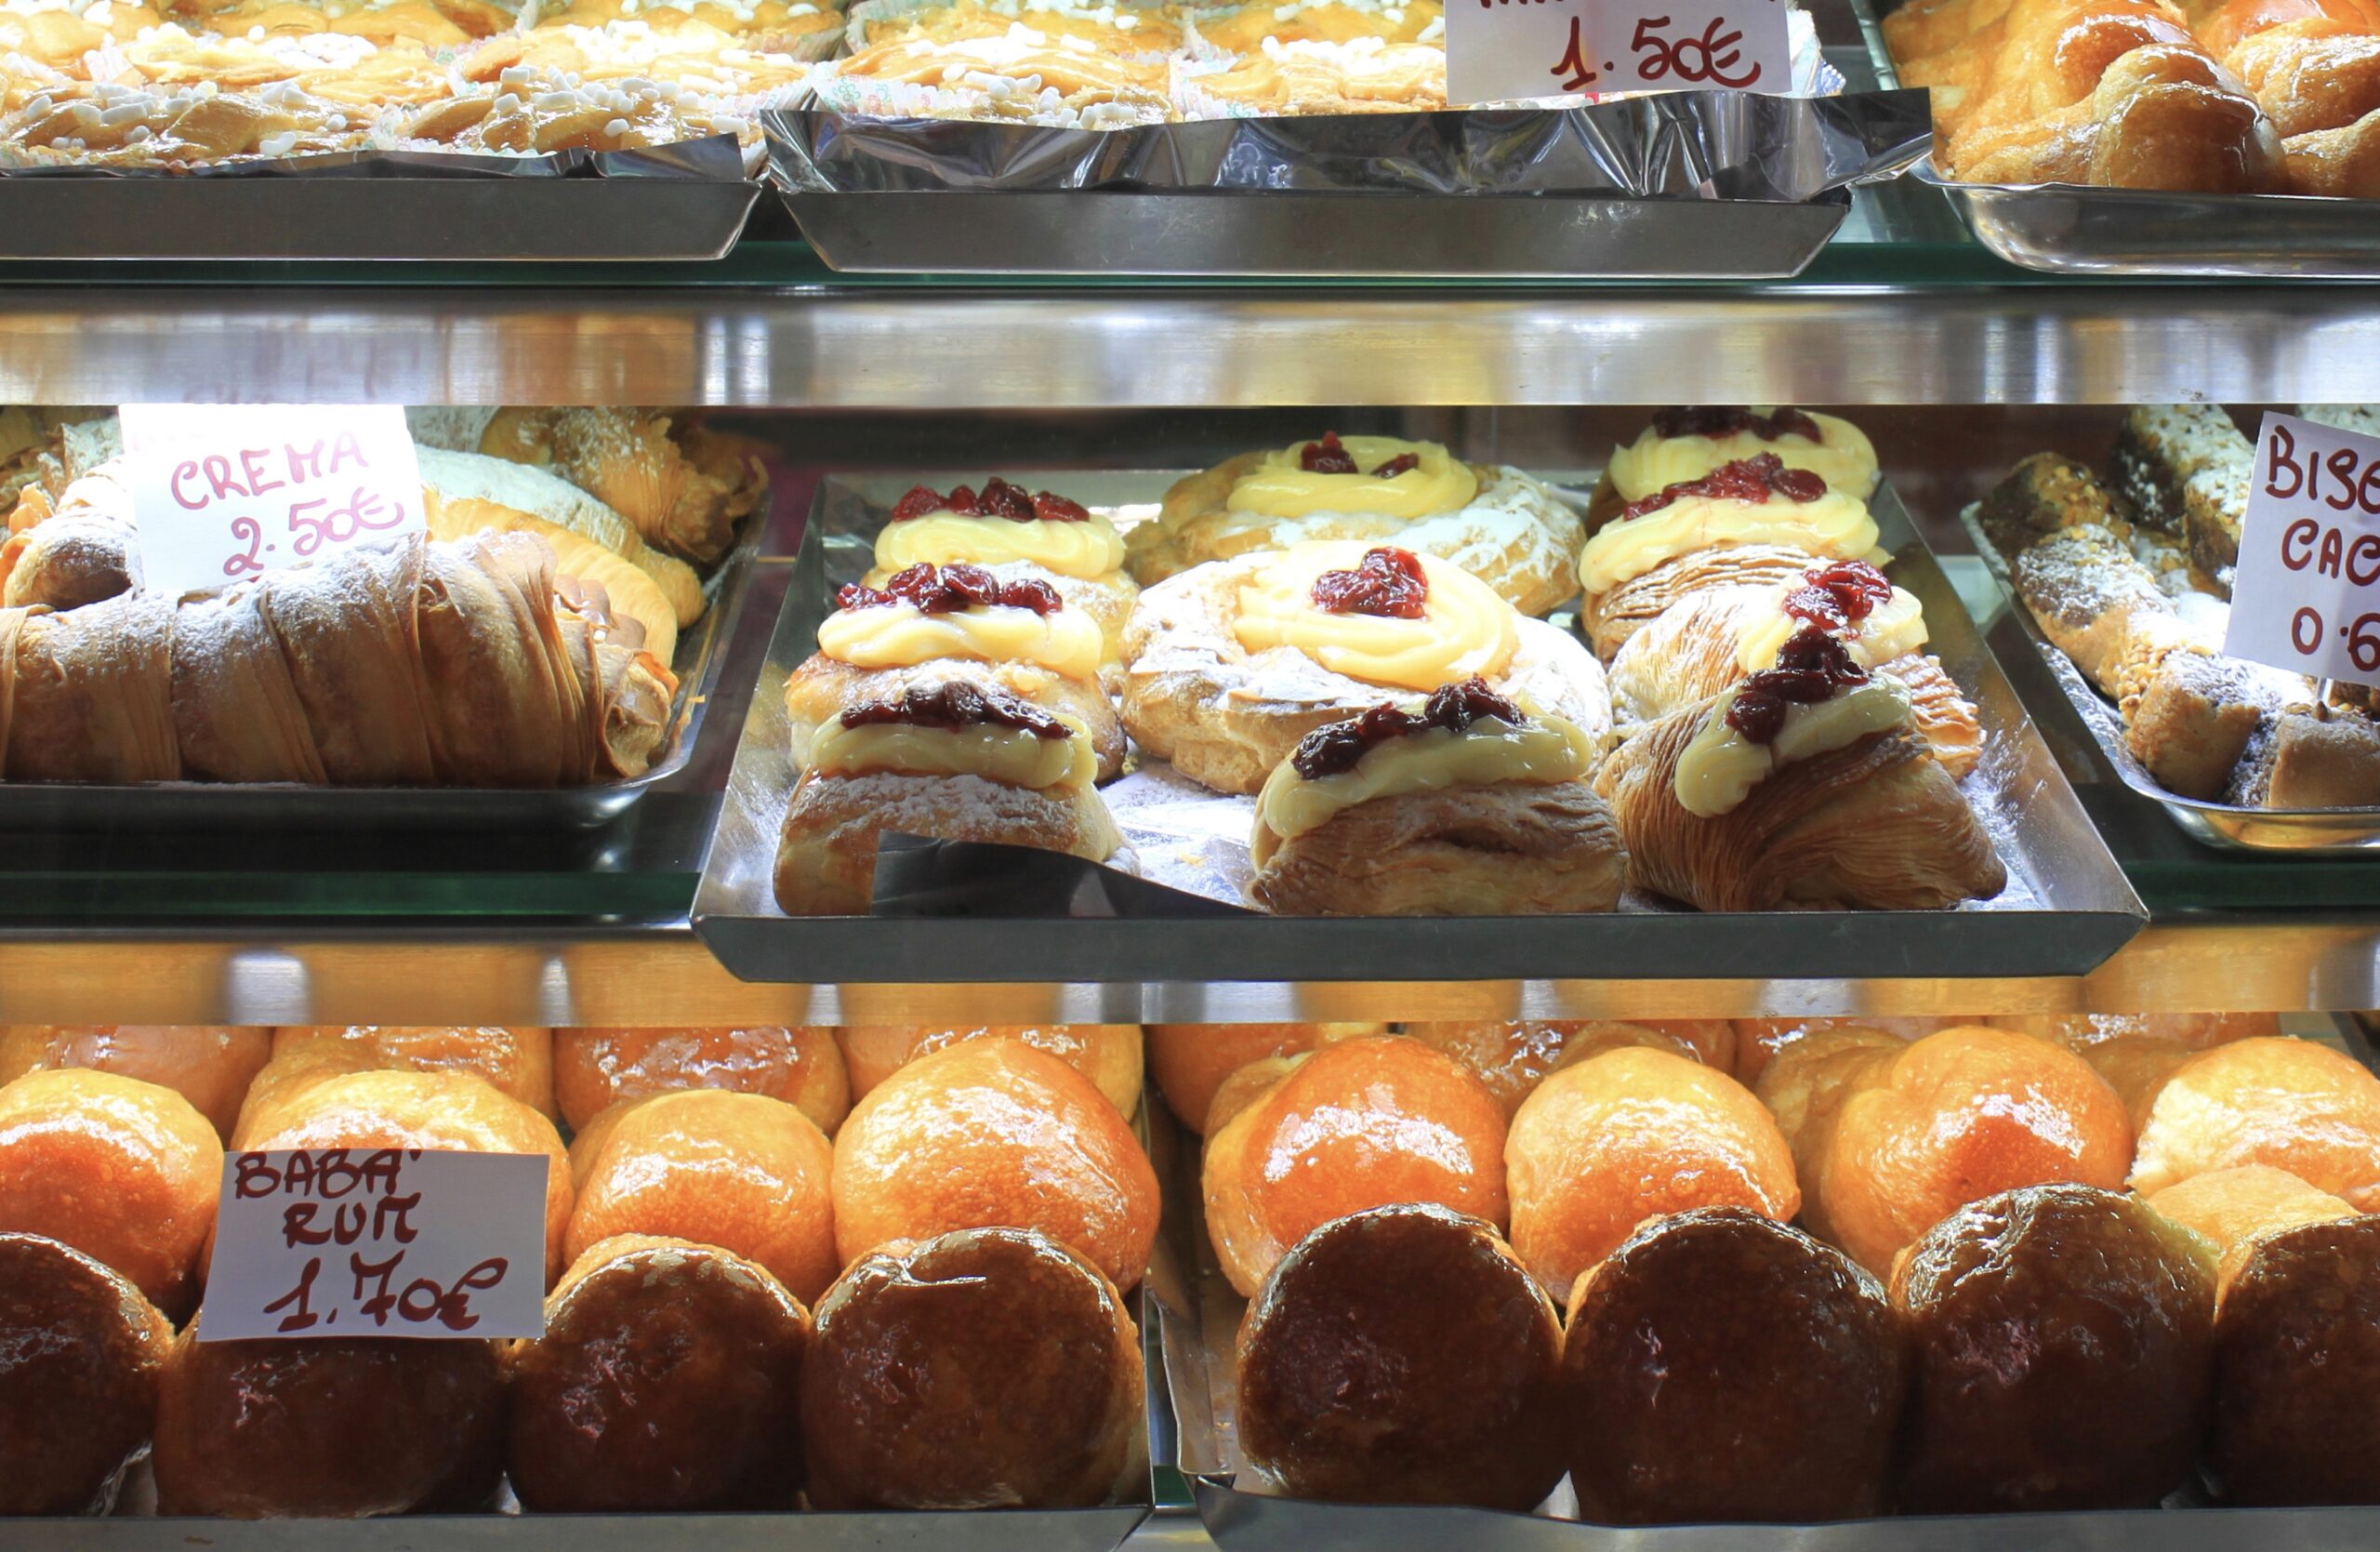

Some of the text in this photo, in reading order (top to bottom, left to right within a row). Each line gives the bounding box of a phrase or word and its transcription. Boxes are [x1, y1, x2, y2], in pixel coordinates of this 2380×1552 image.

[1551, 16, 1762, 91] 1.50€
[171, 430, 369, 511] CREMA
[223, 486, 404, 576] 2.50€
[283, 1191, 422, 1248] RUM
[263, 1249, 509, 1332] 1.70€
